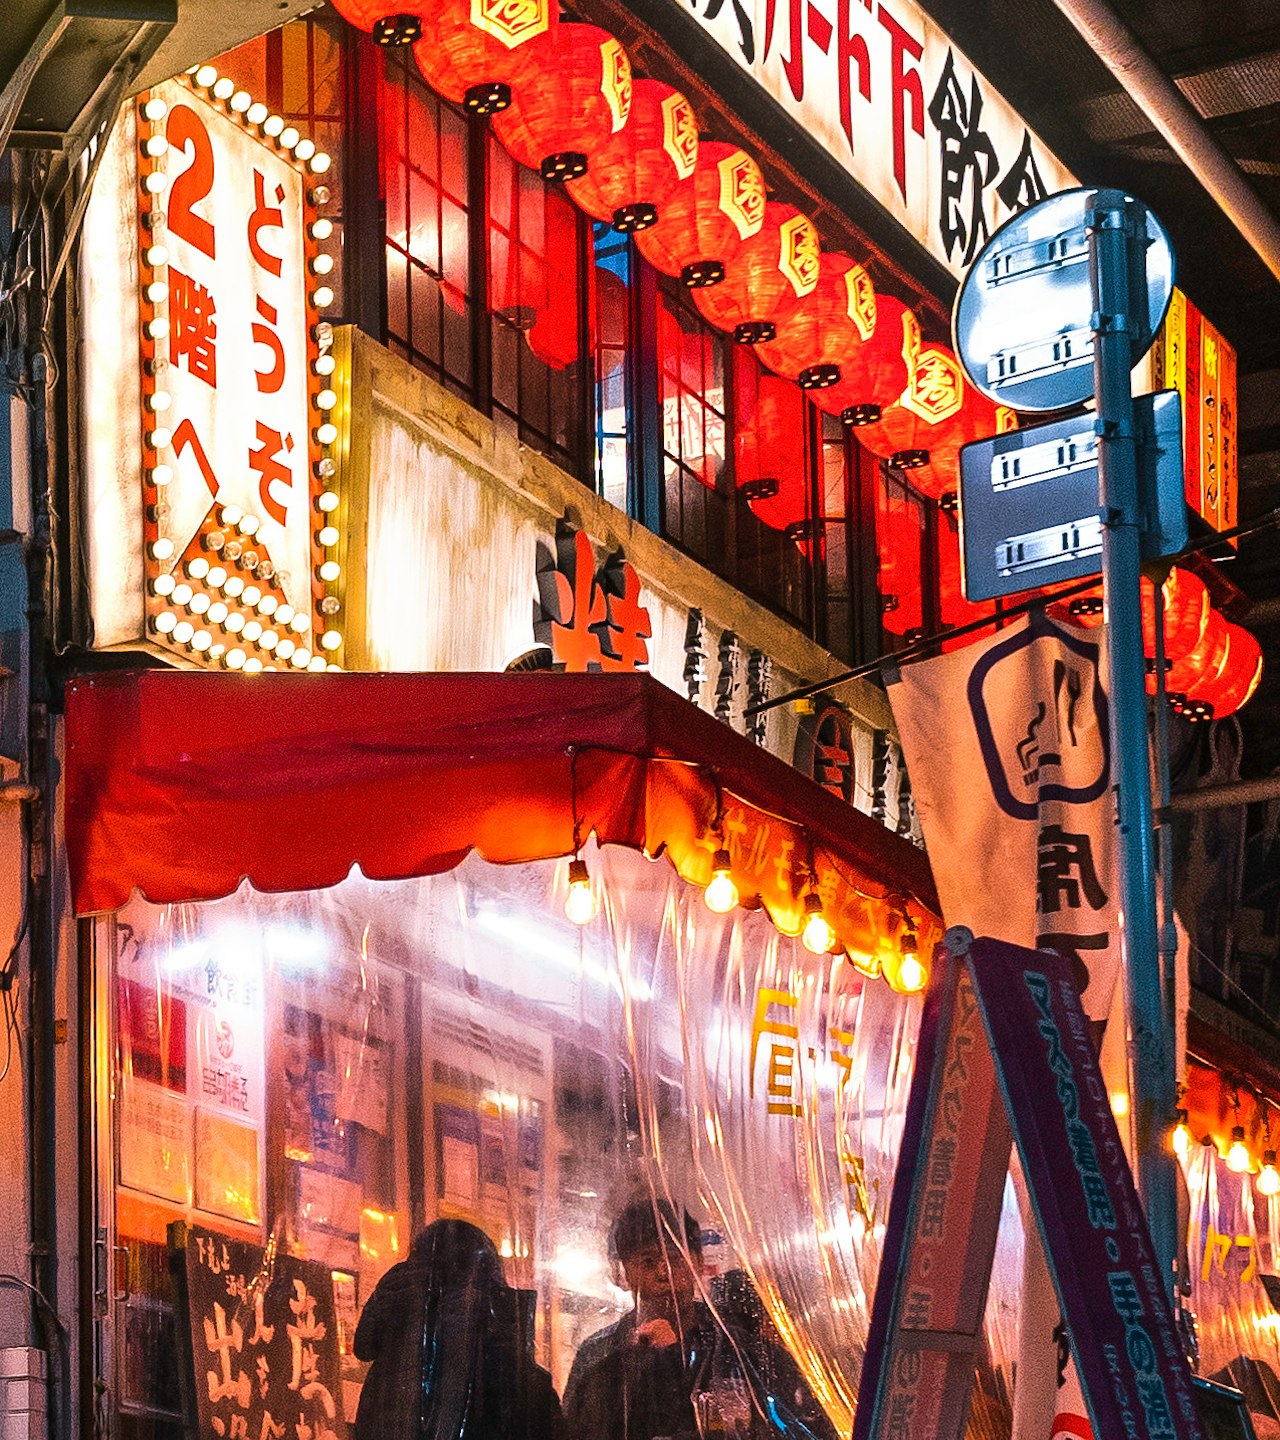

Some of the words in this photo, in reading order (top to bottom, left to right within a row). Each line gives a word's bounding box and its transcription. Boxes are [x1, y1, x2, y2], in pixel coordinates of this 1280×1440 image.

[167, 103, 219, 498] 2階へ
[246, 166, 294, 527] どうぞ
